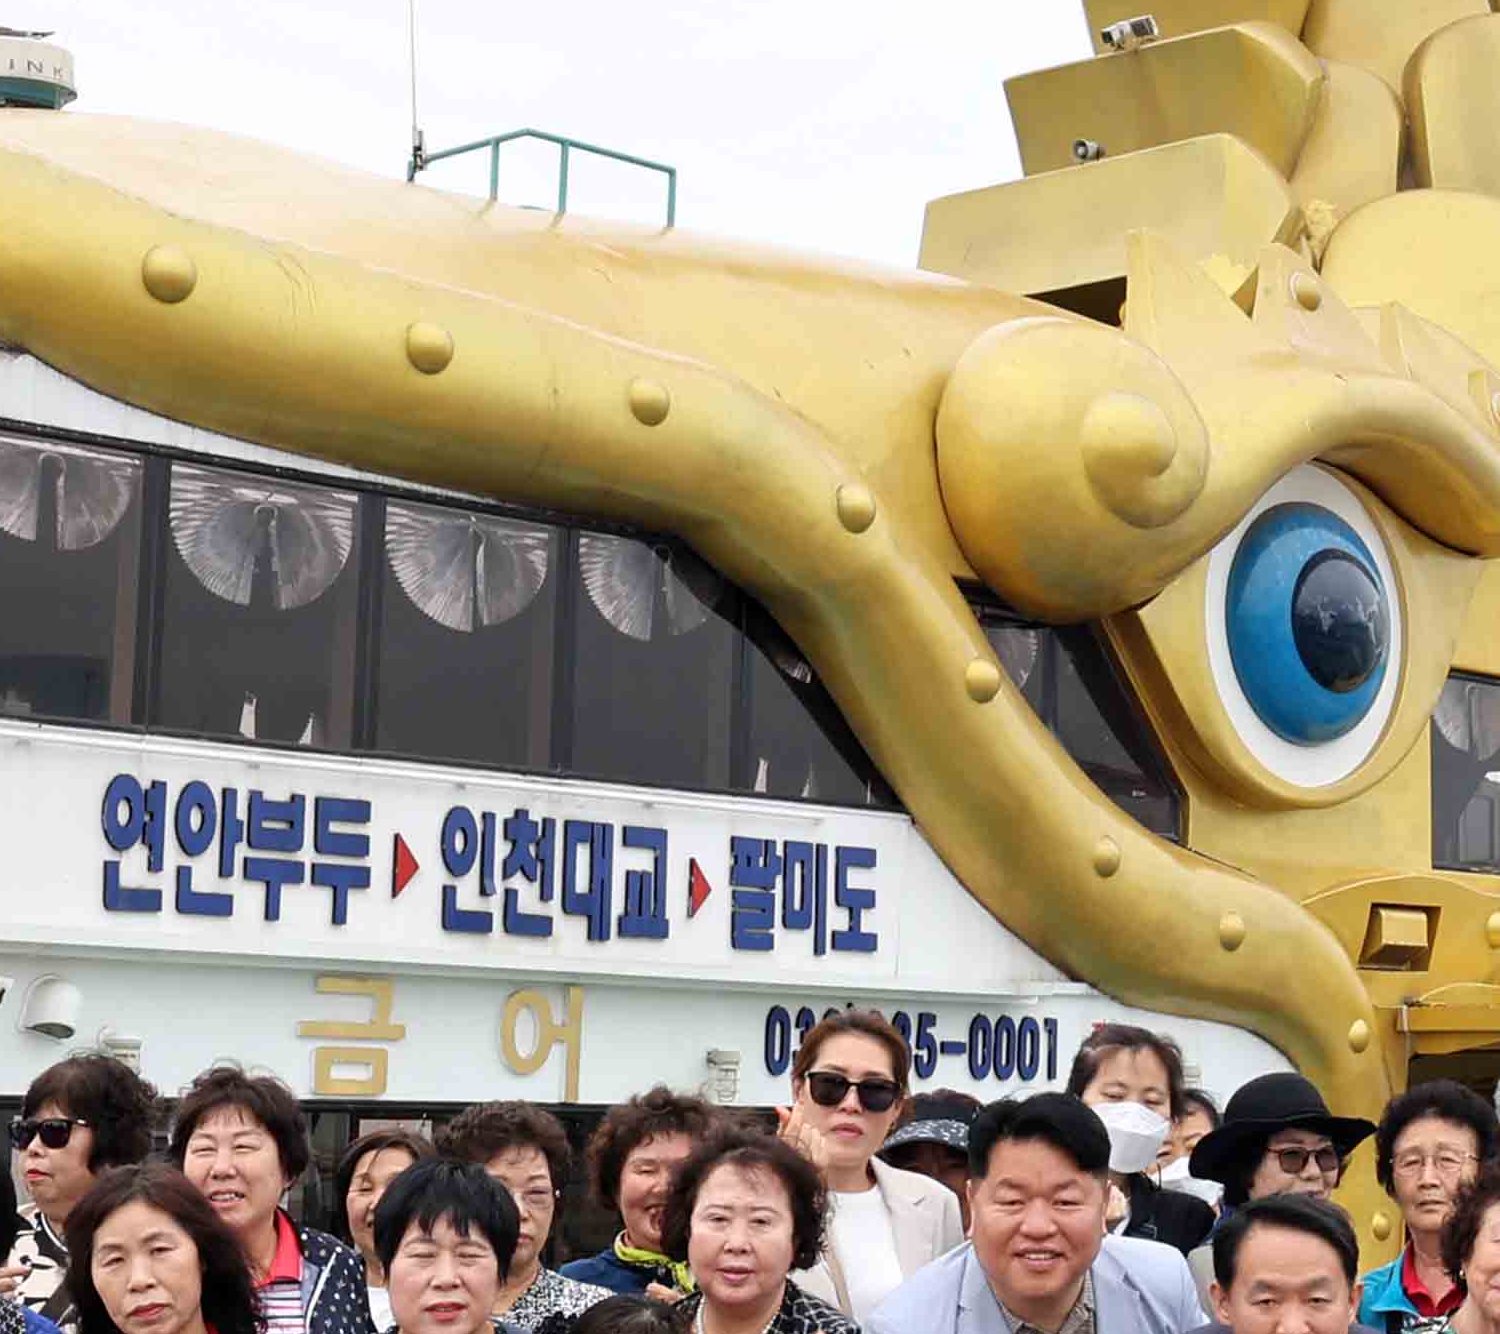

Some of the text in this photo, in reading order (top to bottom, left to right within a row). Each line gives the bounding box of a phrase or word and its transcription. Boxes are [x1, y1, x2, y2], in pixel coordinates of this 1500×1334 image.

[102, 773, 878, 955] 연안부두 인천대교 팔미도
